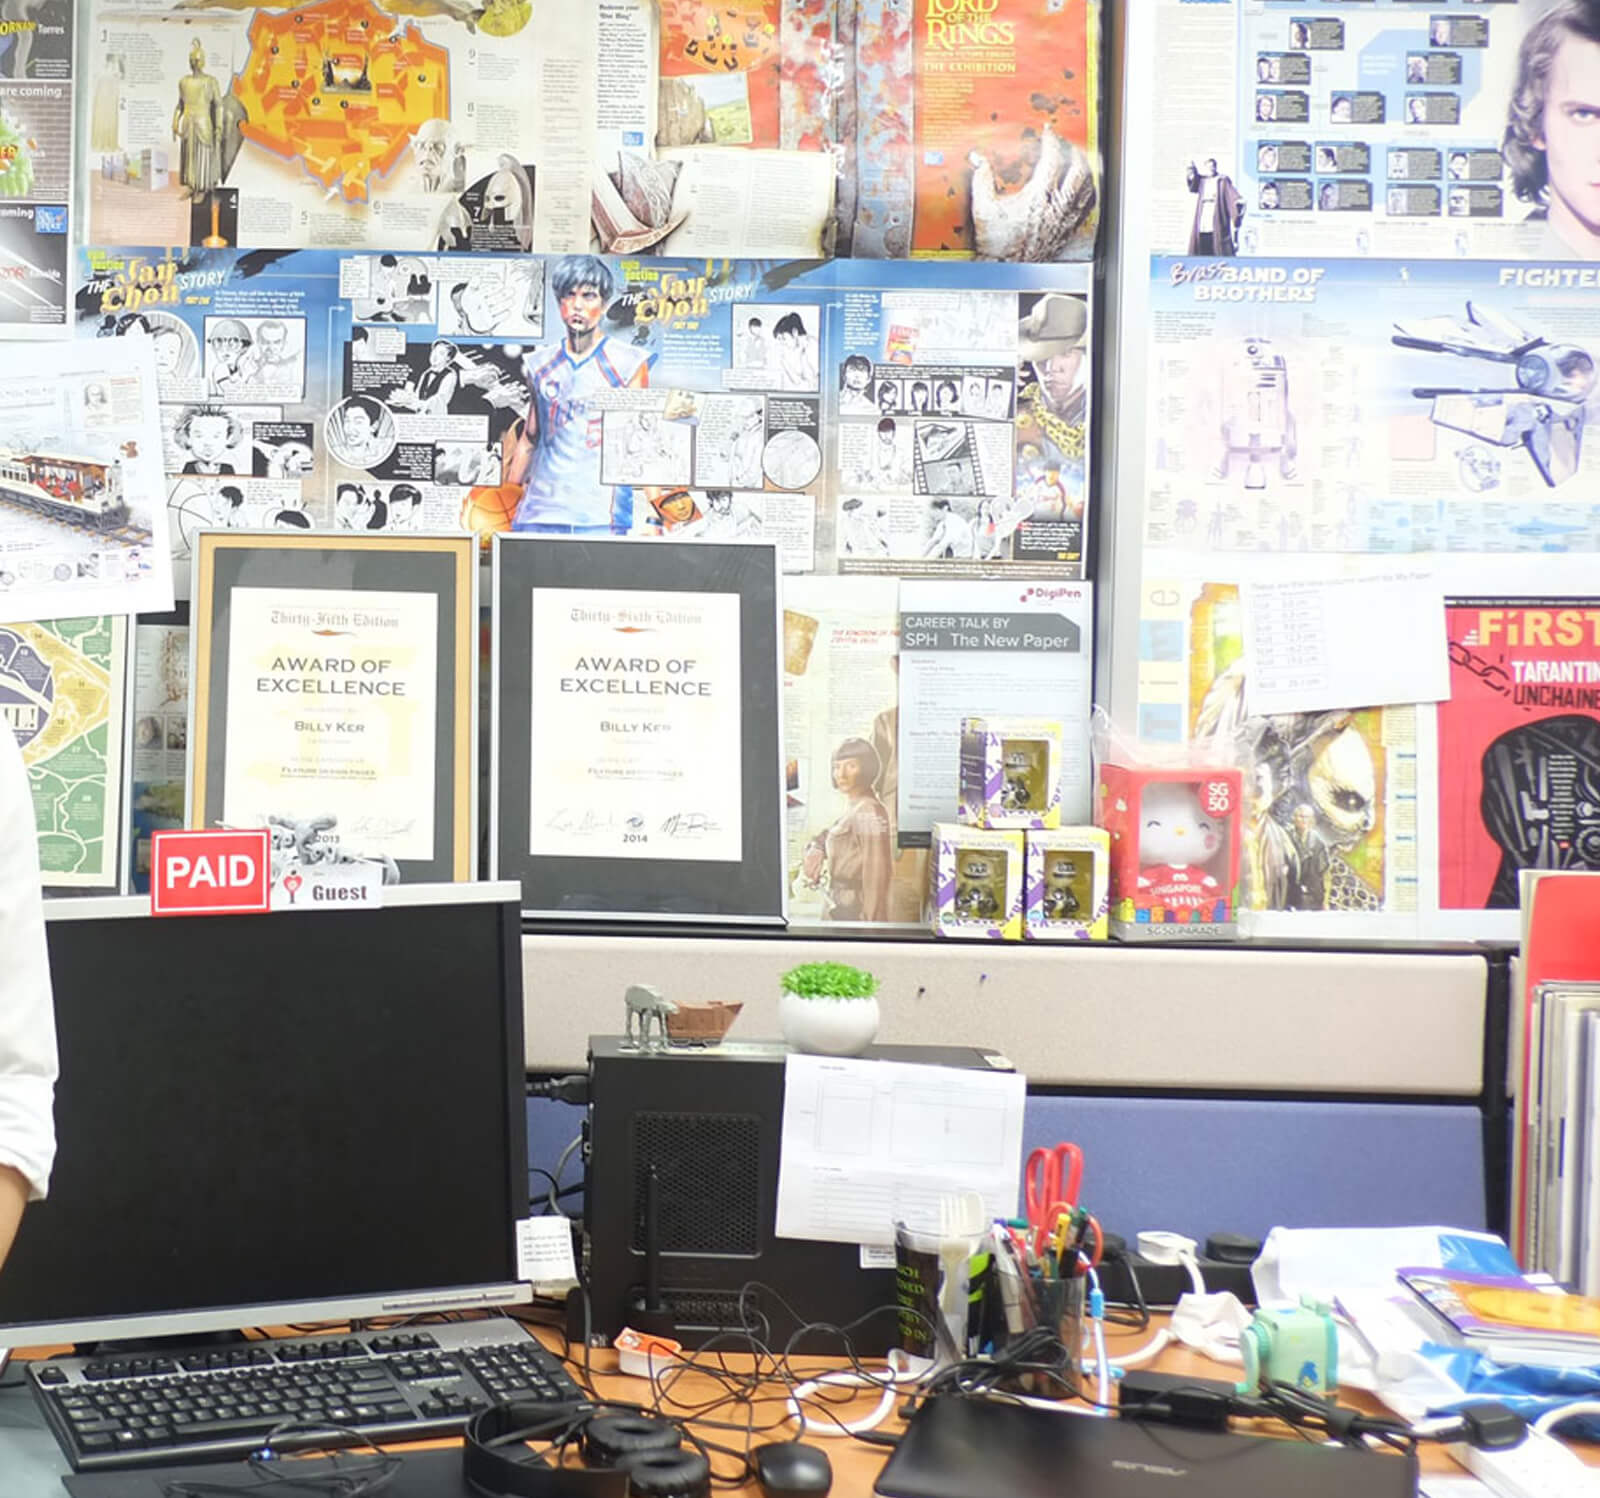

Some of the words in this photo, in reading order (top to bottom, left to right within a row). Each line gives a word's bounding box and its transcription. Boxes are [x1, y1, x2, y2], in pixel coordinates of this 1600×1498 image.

[925, 19, 1015, 50] RINGS
[949, 63, 1017, 73] EXHIBITION
[0, 86, 18, 97] are
[19, 85, 63, 99] coming
[180, 269, 226, 291] STORY
[1223, 267, 1287, 285] BAND
[1293, 268, 1325, 285] OF
[1498, 267, 1600, 288] FIGHTE
[1194, 284, 1317, 303] BROTHERS
[1035, 587, 1082, 600] DigiPen
[271, 609, 350, 629] Thirty-Fifth
[353, 611, 400, 629] Edition
[905, 617, 957, 629] CAREER
[959, 617, 990, 629] TALK
[992, 617, 1011, 629] BY
[905, 632, 938, 647] SPH
[950, 632, 980, 647] The
[983, 633, 1020, 648] New
[1023, 633, 1070, 650] Paper
[271, 656, 356, 675] AWARD
[361, 659, 392, 675] OF
[574, 656, 660, 674] AWARD
[666, 659, 698, 675] OF
[256, 677, 406, 697] EXCELLENCE
[560, 677, 712, 697] EXCELLENCE
[294, 720, 332, 733] BILLY
[600, 720, 639, 733] BILLY
[1207, 782, 1229, 796] SG
[1207, 797, 1229, 811] 50
[623, 832, 648, 844] 2014
[165, 854, 256, 889] PAID
[312, 884, 367, 901] Guest
